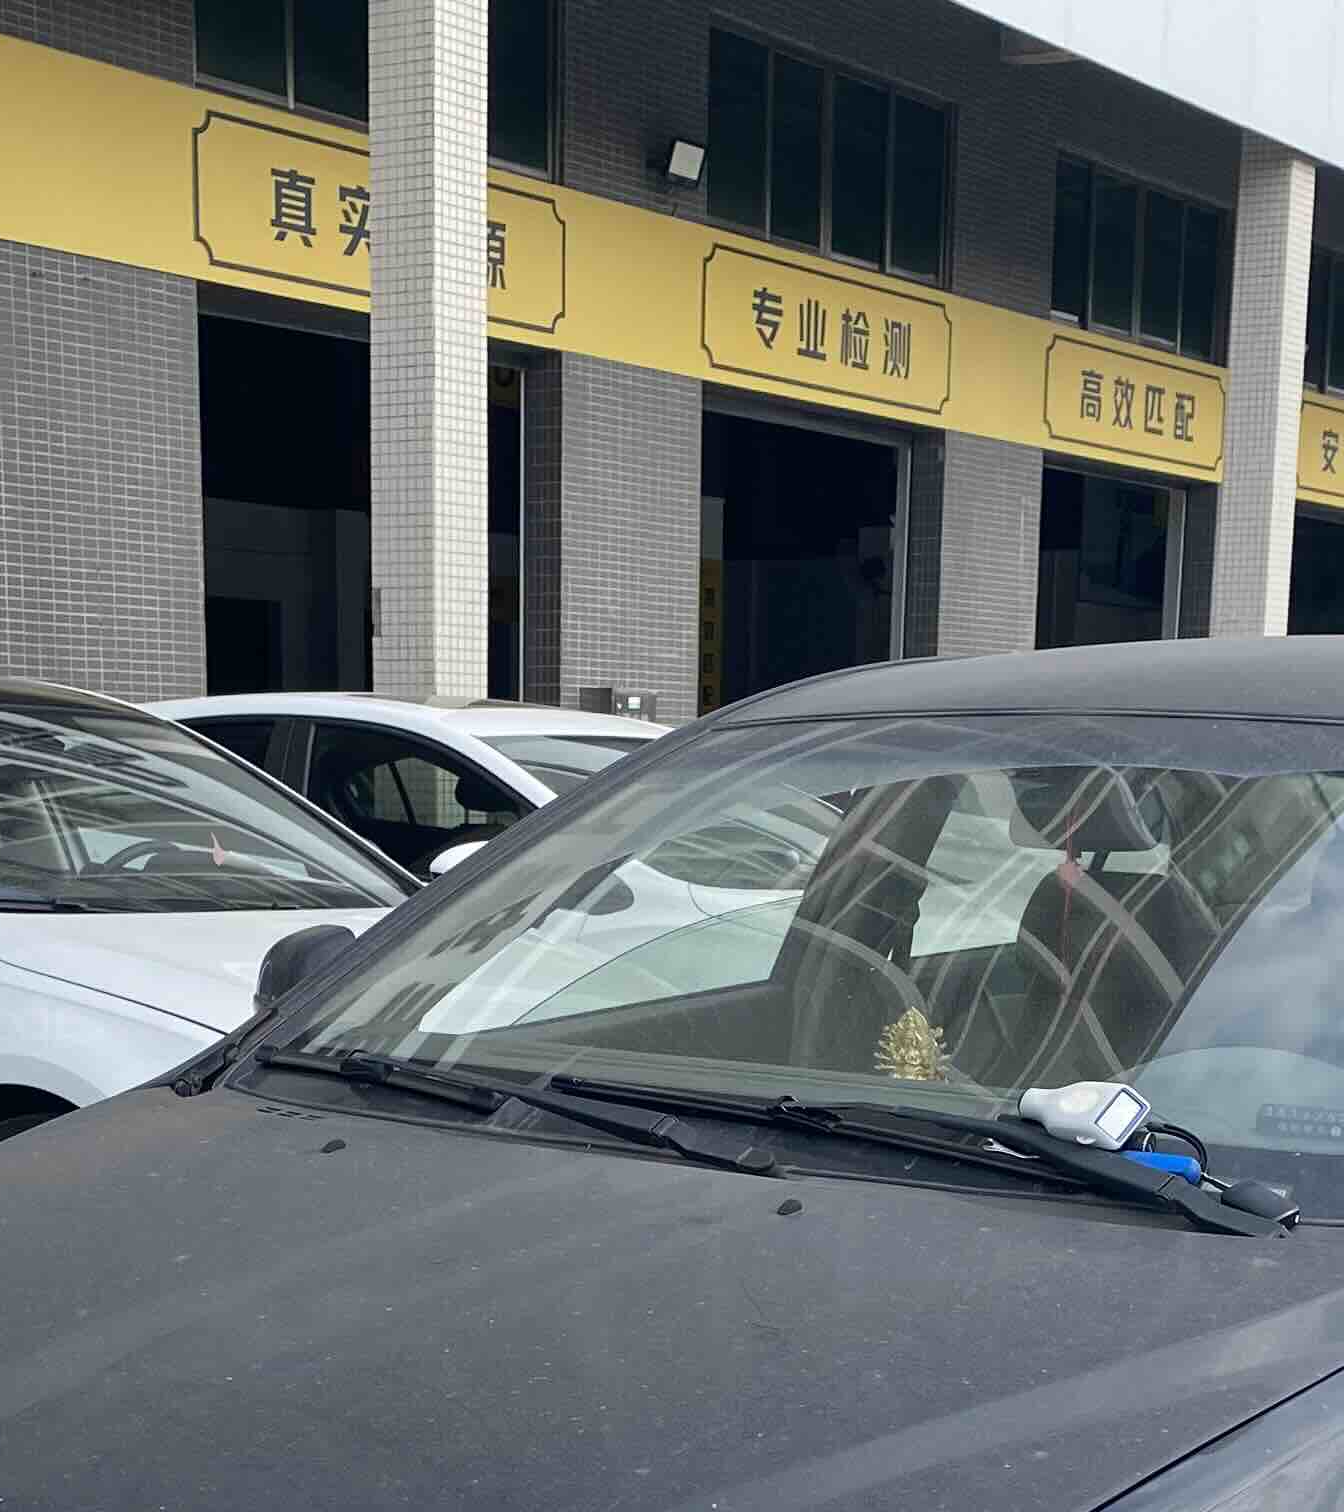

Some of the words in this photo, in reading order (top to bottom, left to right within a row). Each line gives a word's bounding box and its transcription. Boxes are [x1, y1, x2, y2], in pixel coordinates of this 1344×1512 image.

[751, 286, 912, 381] 专业检测
[1079, 368, 1196, 443] 高效匹配
